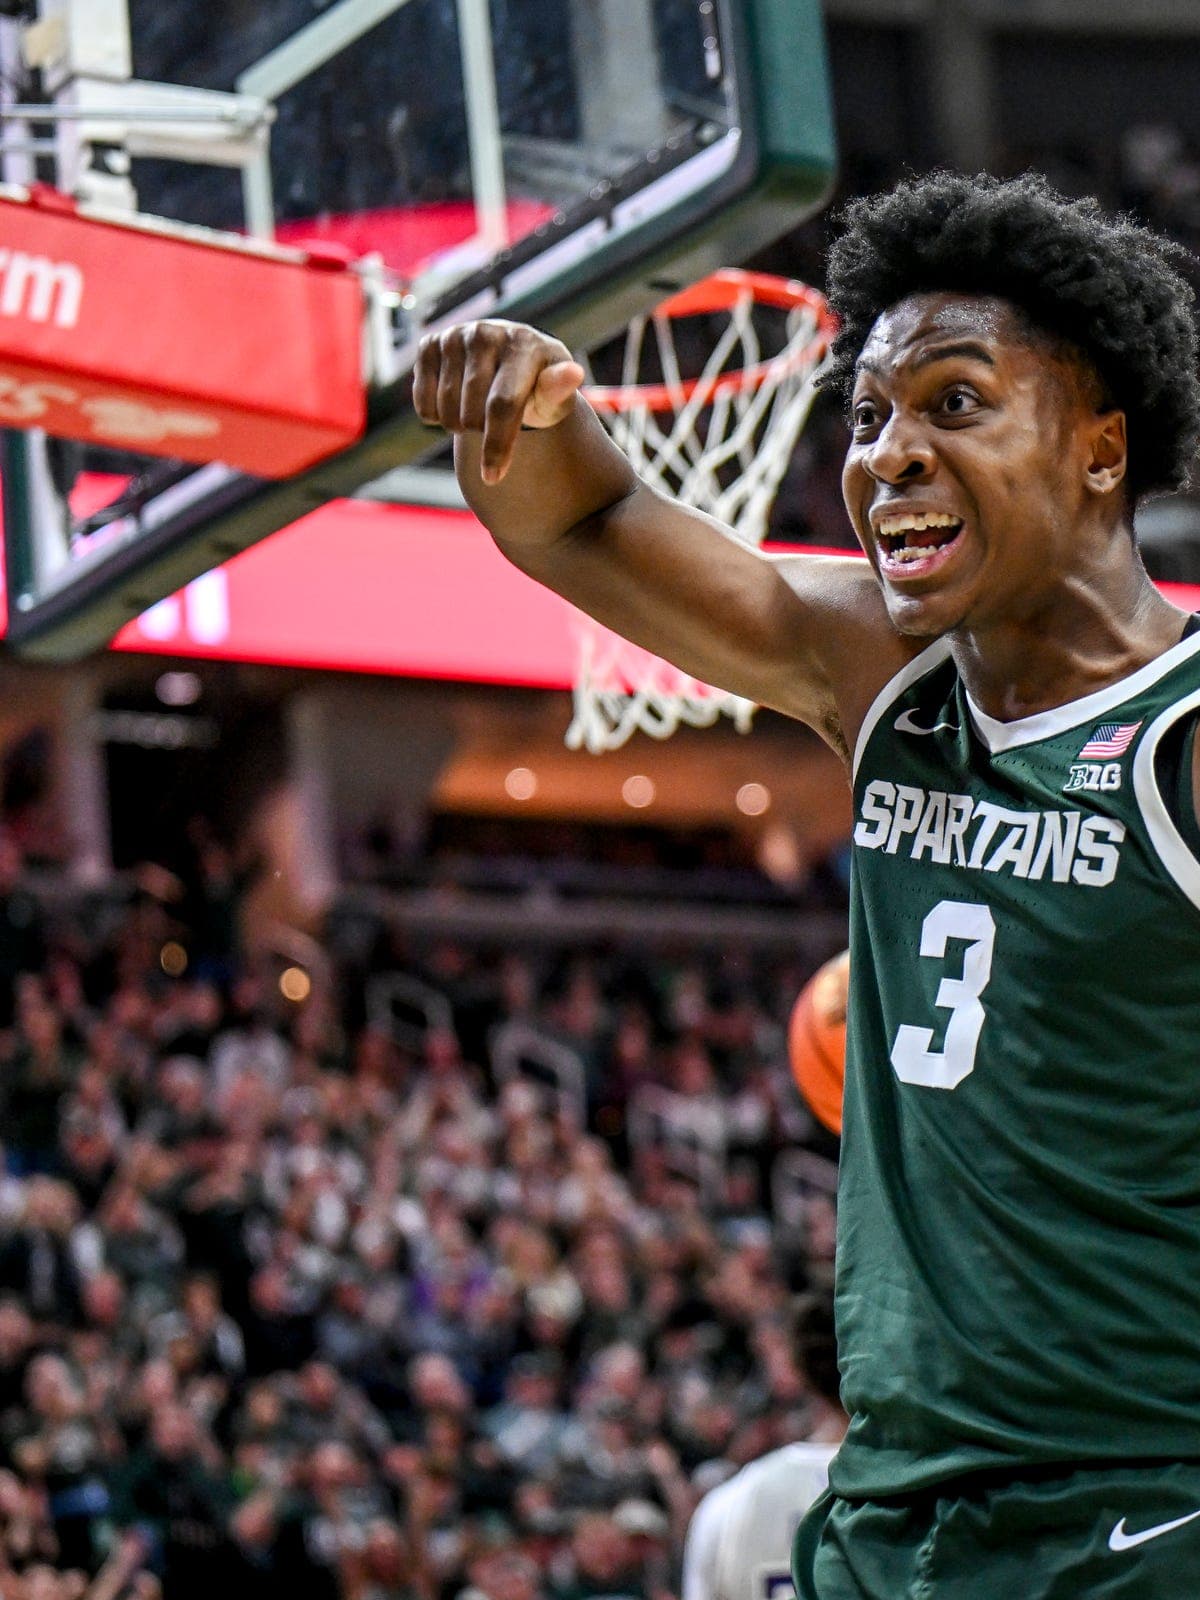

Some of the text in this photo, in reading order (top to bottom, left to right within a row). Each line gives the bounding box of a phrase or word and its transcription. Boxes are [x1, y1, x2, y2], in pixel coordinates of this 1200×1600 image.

[0, 248, 84, 329] m
[854, 779, 1126, 887] SPARTANS
[890, 901, 996, 1090] 3
